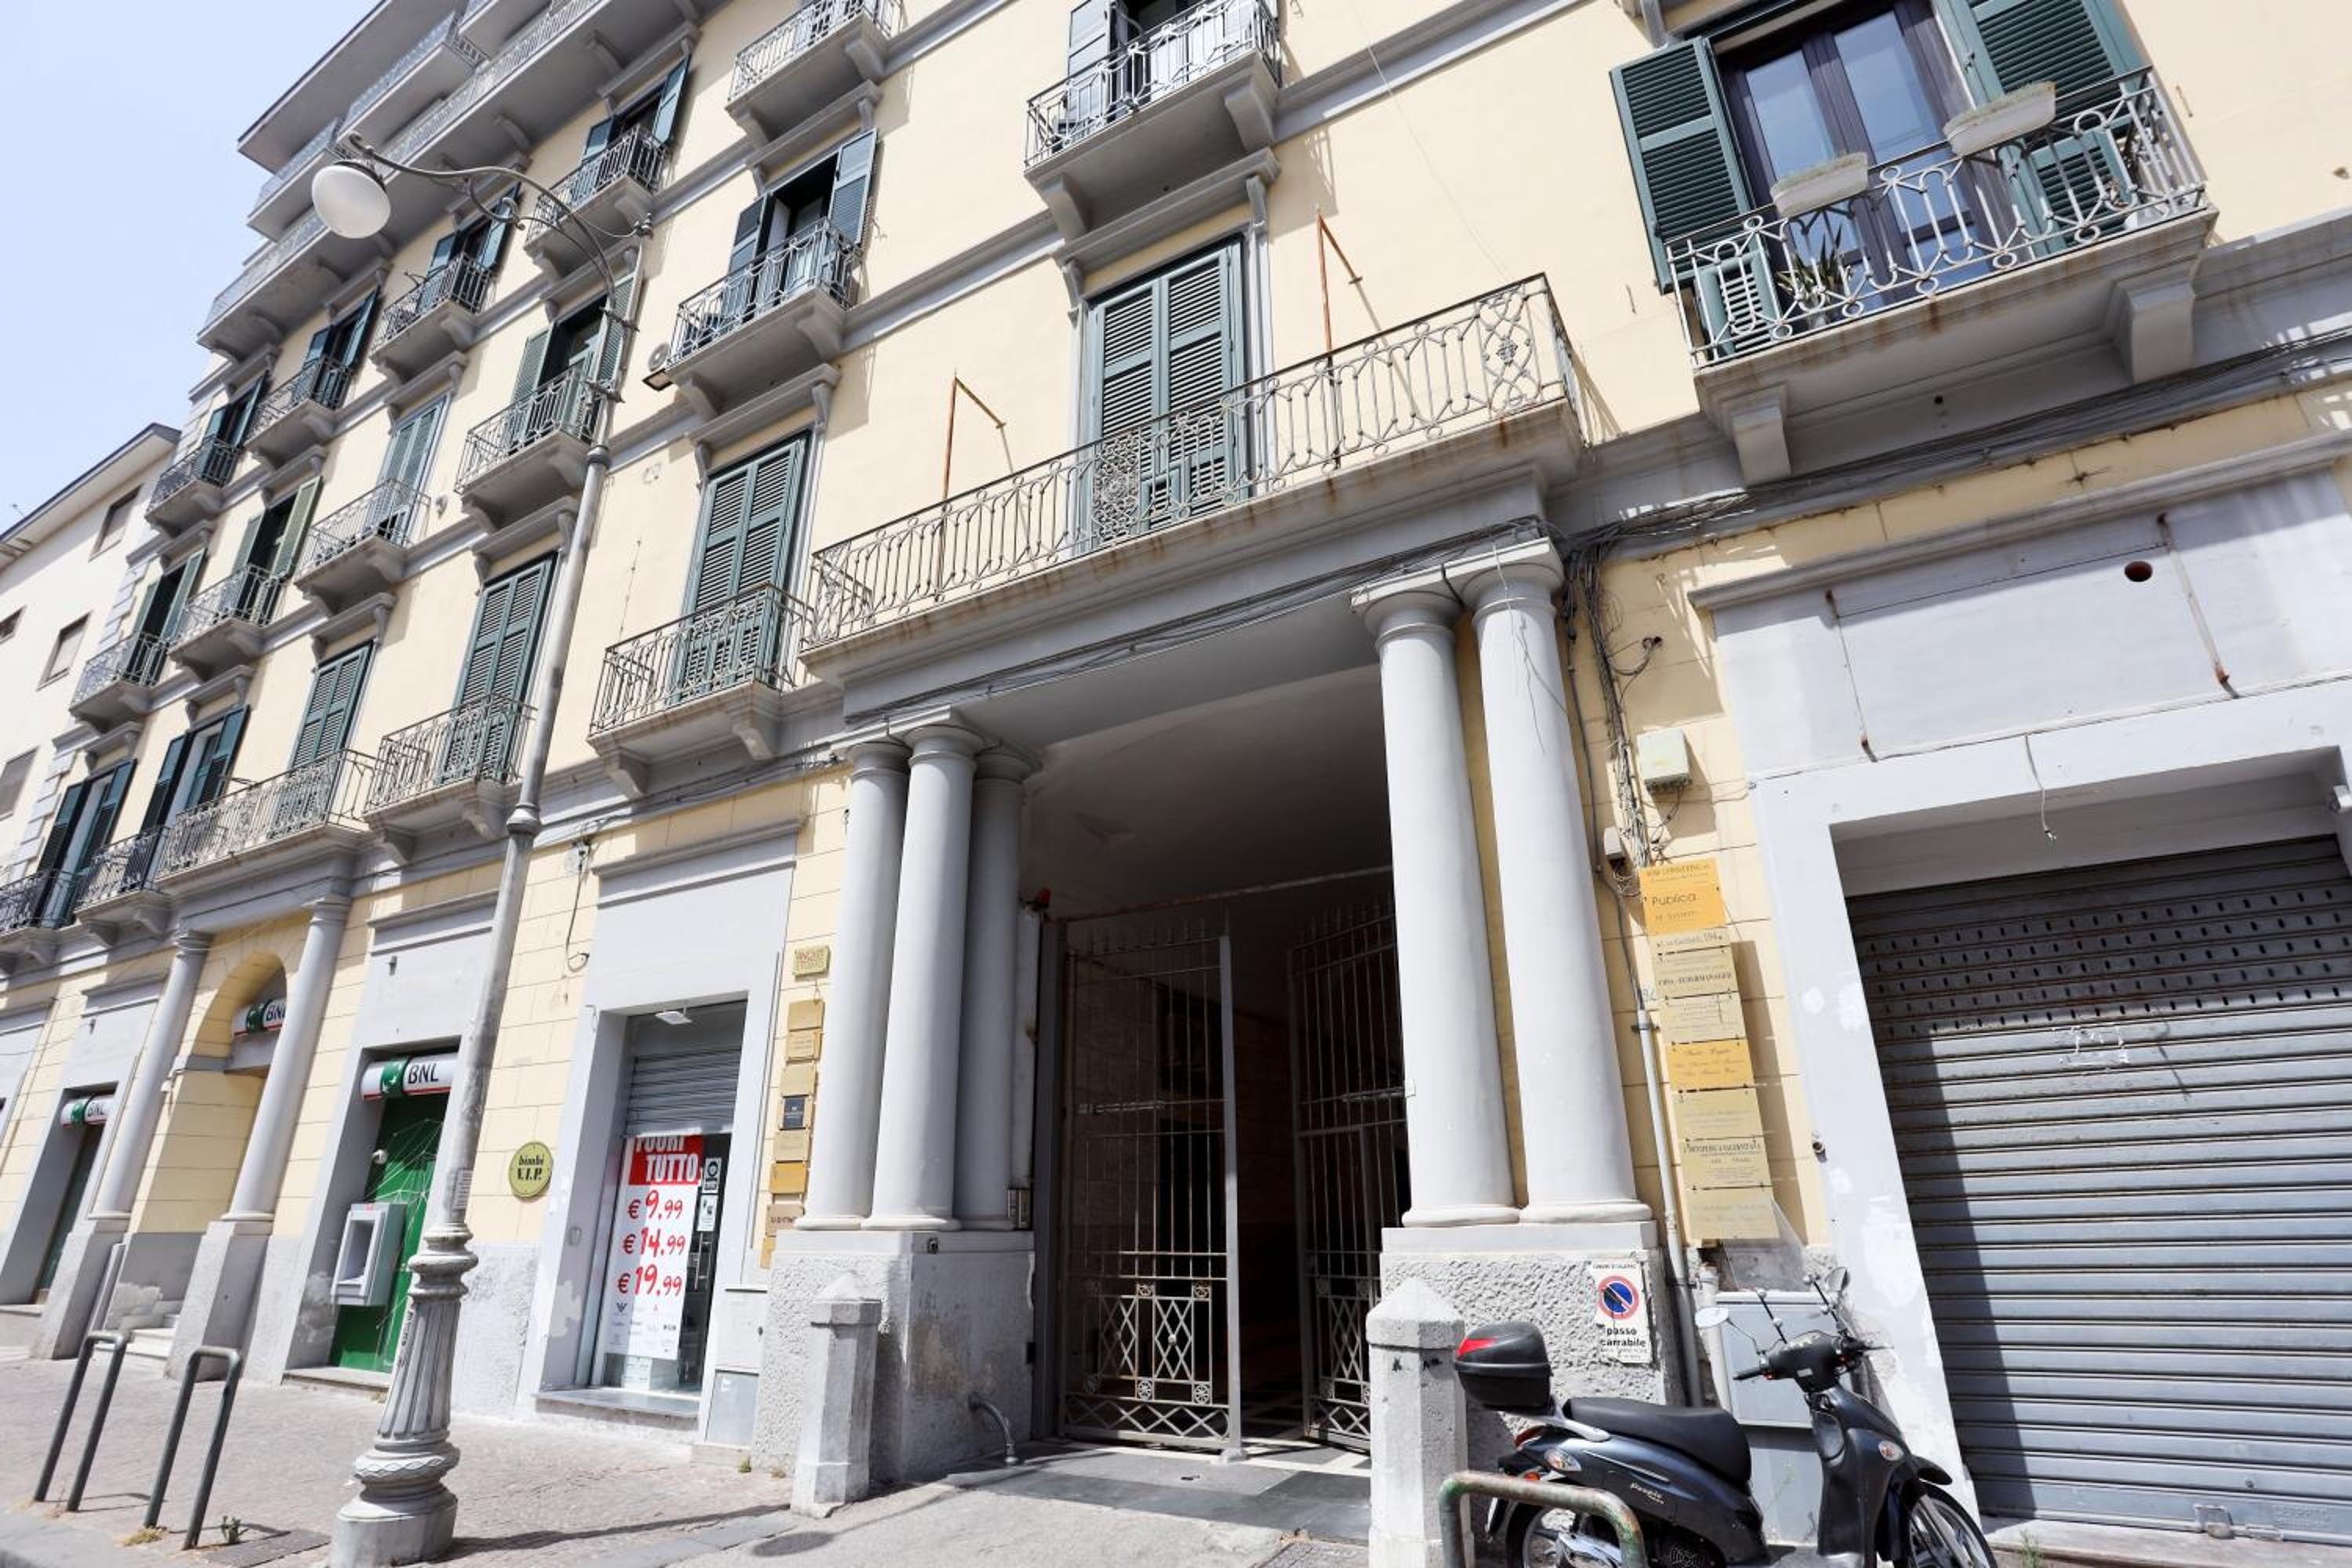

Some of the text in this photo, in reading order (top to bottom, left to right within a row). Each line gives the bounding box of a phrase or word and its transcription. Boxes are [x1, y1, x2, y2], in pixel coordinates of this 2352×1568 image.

[407, 1063, 439, 1084] BNL
[88, 1102, 105, 1117] BNL
[518, 1153, 545, 1166] bimbi
[645, 1153, 699, 1183] TUTTO
[517, 1167, 543, 1181] V.I.P.
[628, 1189, 683, 1220] € 9.99
[623, 1227, 685, 1258] € 14.99
[618, 1264, 682, 1297] € 19.99
[1606, 1327, 1637, 1336] passo
[1599, 1338, 1646, 1348] carrabile
